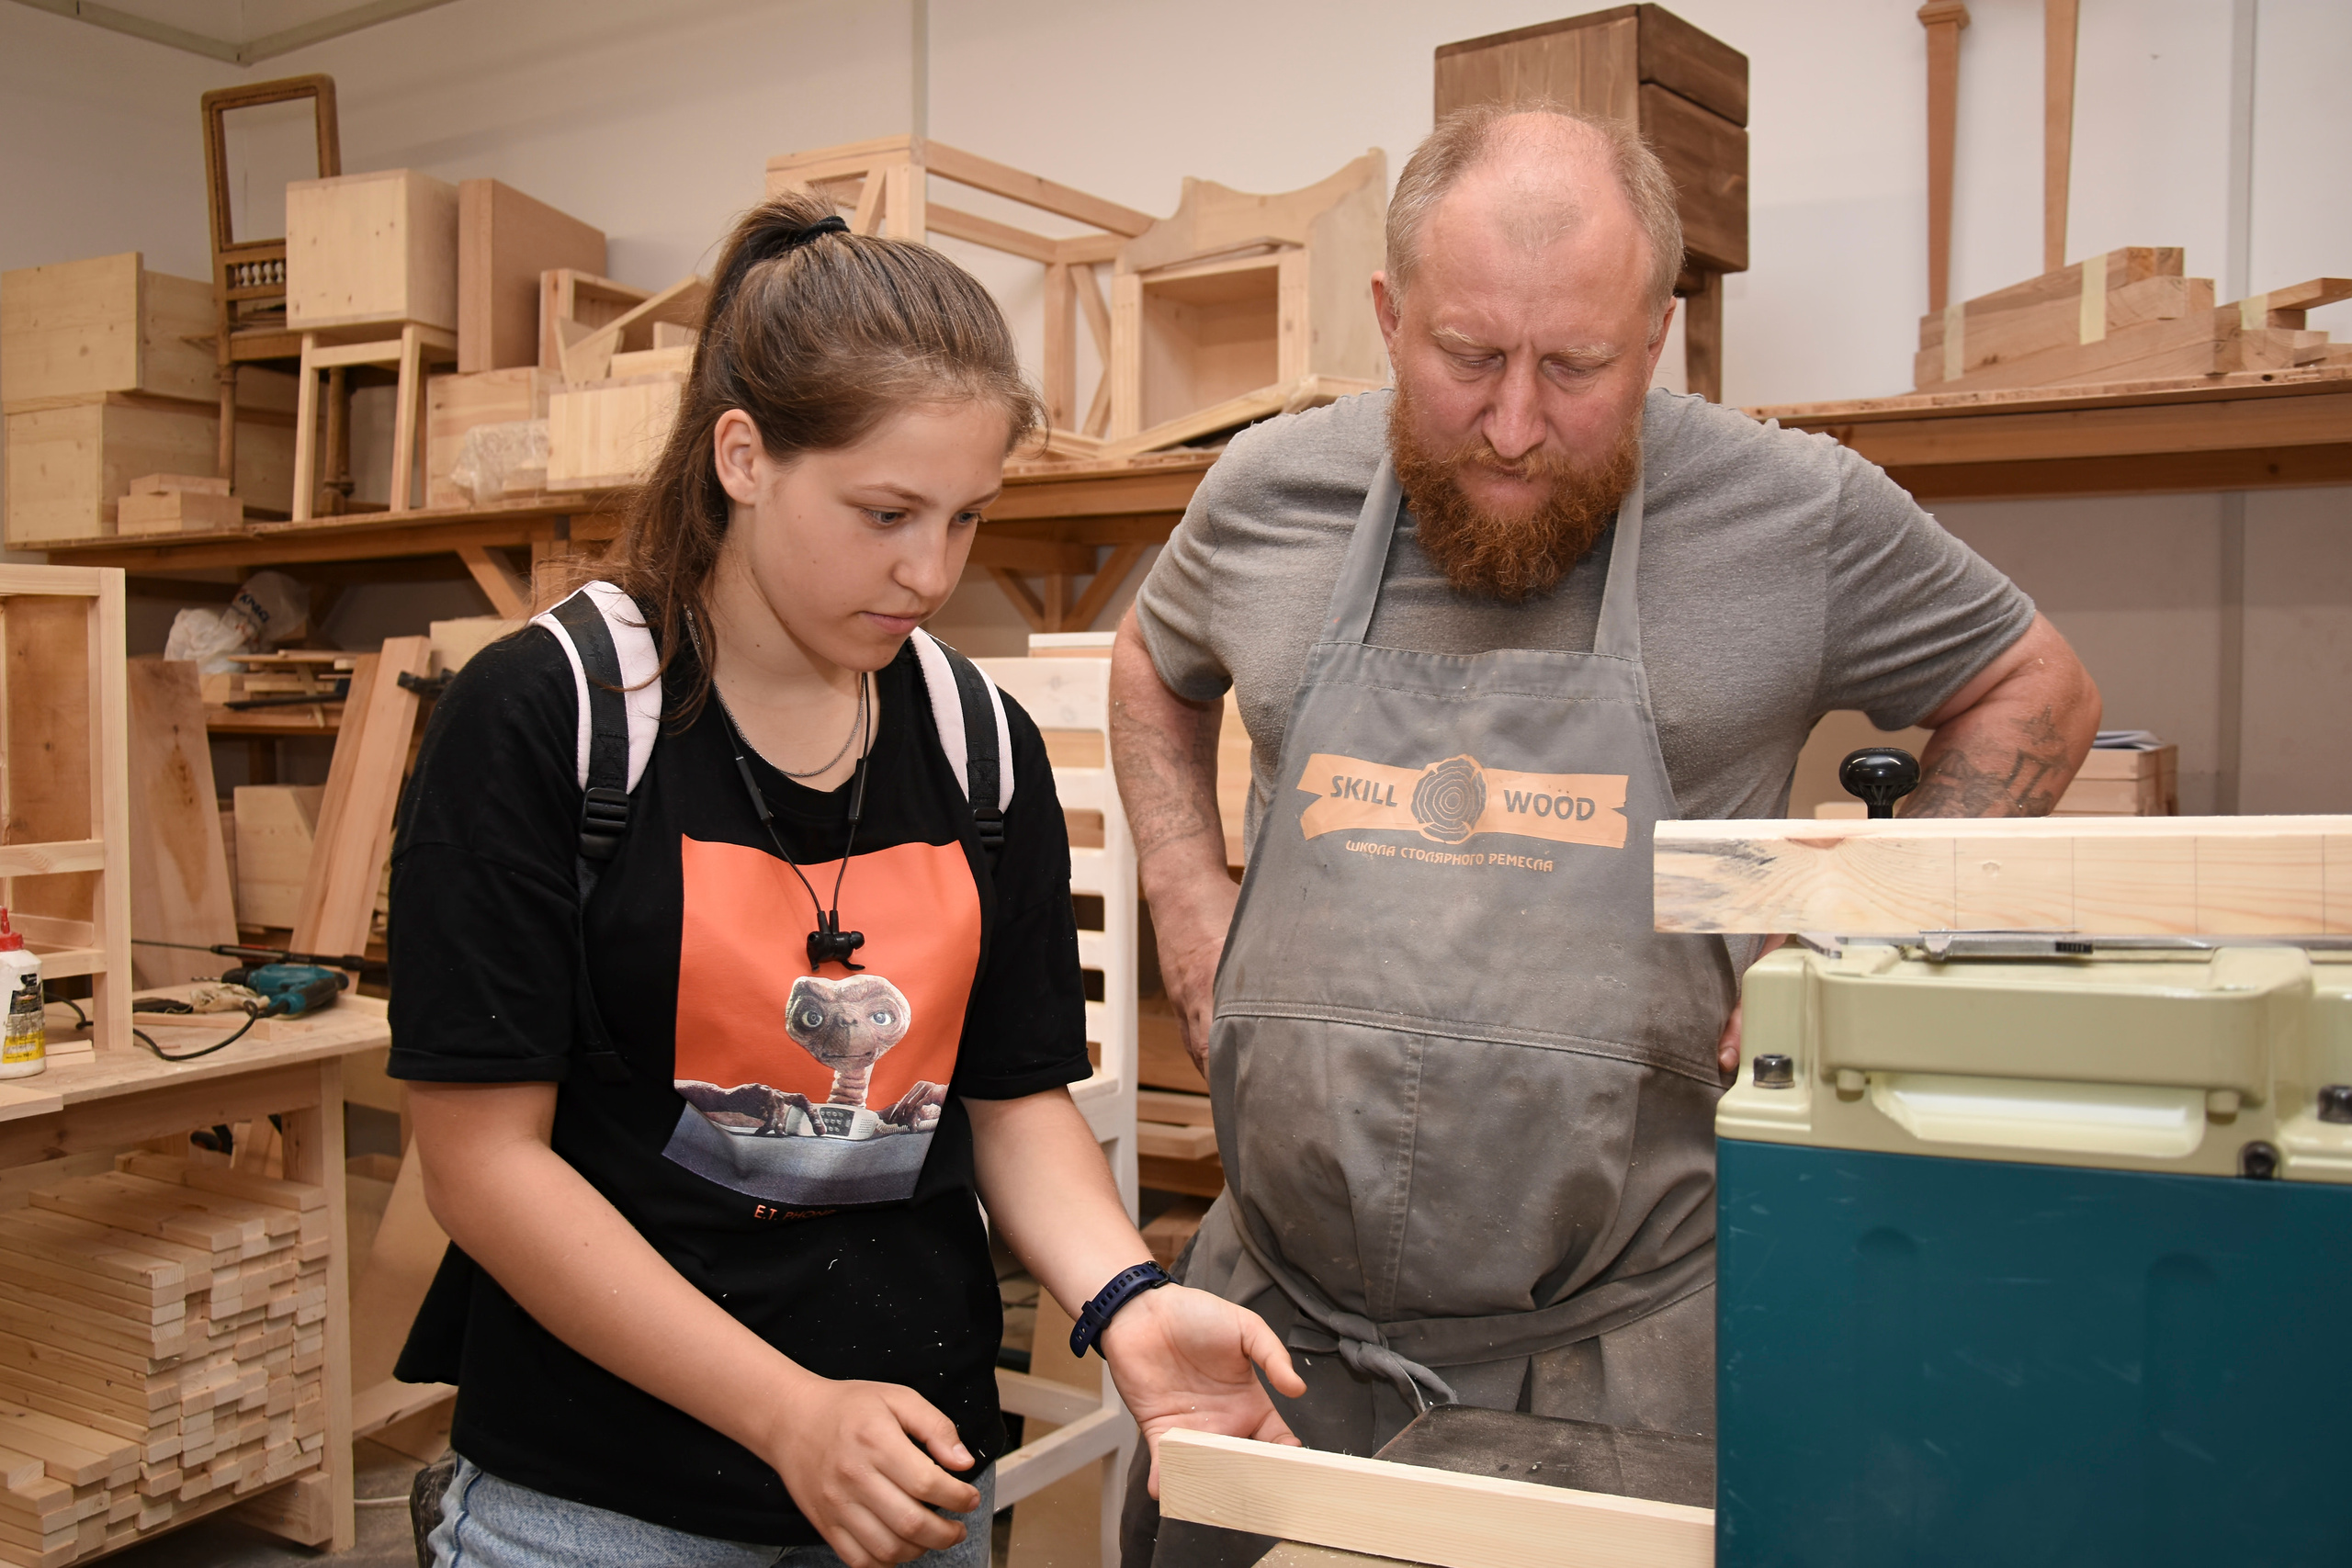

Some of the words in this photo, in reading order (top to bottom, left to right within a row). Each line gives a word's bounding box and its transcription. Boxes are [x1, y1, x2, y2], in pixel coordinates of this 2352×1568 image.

[1329, 775, 1398, 807] SKILL
[1503, 789, 1596, 821] WOOD
[1345, 840, 1396, 857] ШКОЛА
[1400, 847, 1485, 866] СТОЛЯРНОГО
[1488, 852, 1554, 873] РЕМЕСЛА
[753, 1204, 778, 1221] E.T.
